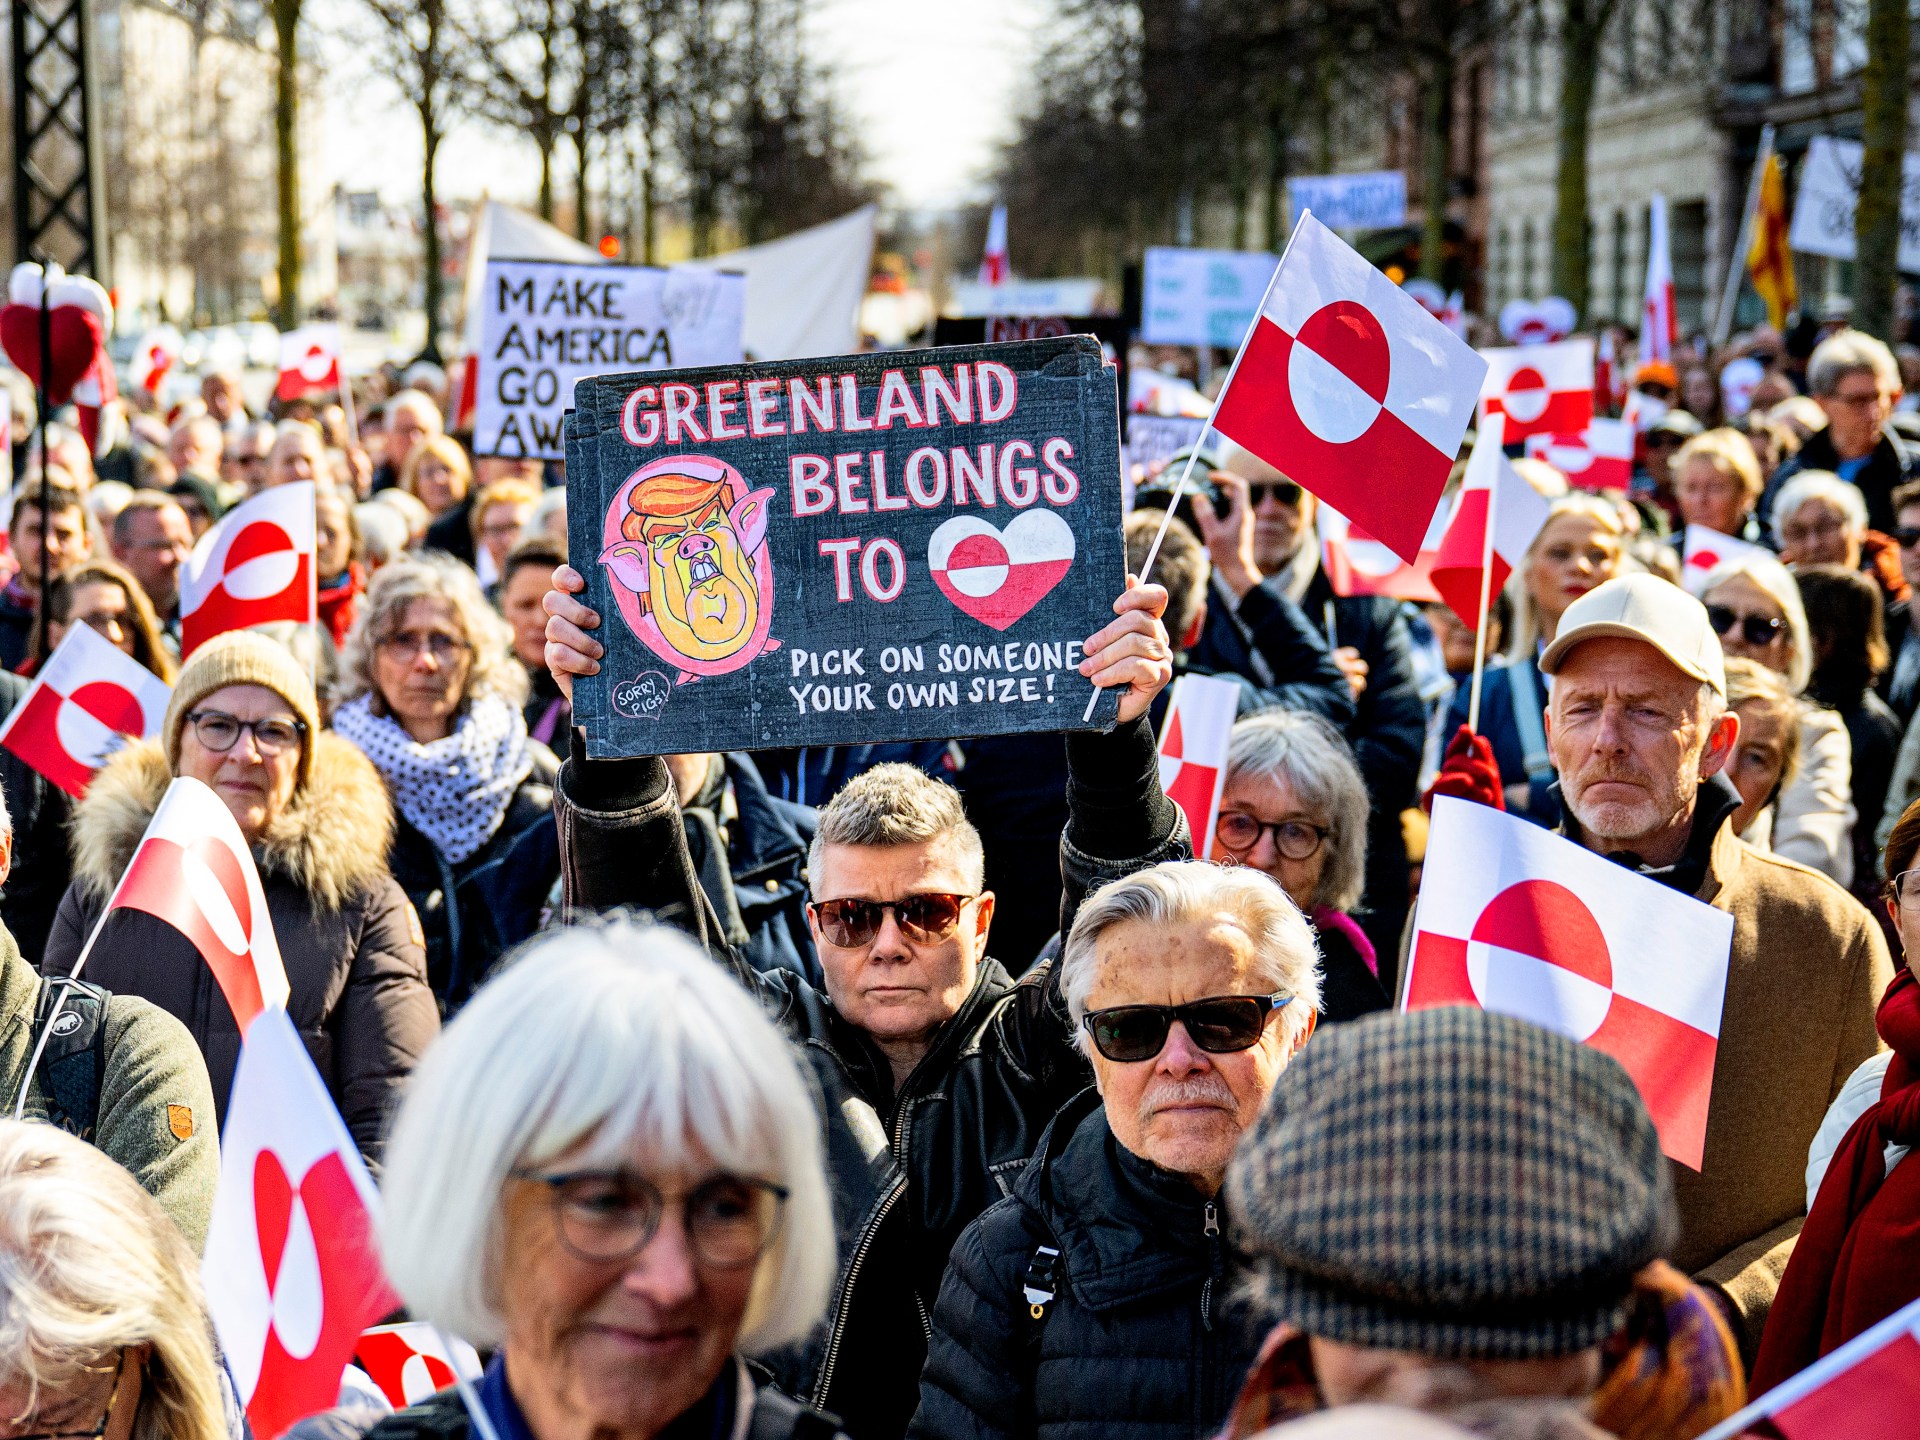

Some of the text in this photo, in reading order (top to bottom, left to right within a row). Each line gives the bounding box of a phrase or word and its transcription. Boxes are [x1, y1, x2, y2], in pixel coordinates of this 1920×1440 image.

[499, 277, 625, 319] MAKE
[495, 324, 674, 365] AMERICA
[497, 368, 560, 406] GO
[621, 362, 1018, 446] GREENLAND
[493, 412, 564, 456] AW
[790, 437, 1078, 519] BELONGS
[819, 537, 906, 603] TO
[792, 640, 1083, 677] PICK ON SOMEONE
[618, 678, 655, 706] SORRY
[631, 690, 669, 716] PIGS!
[788, 674, 1055, 715] YOUR OWN SIZE!
